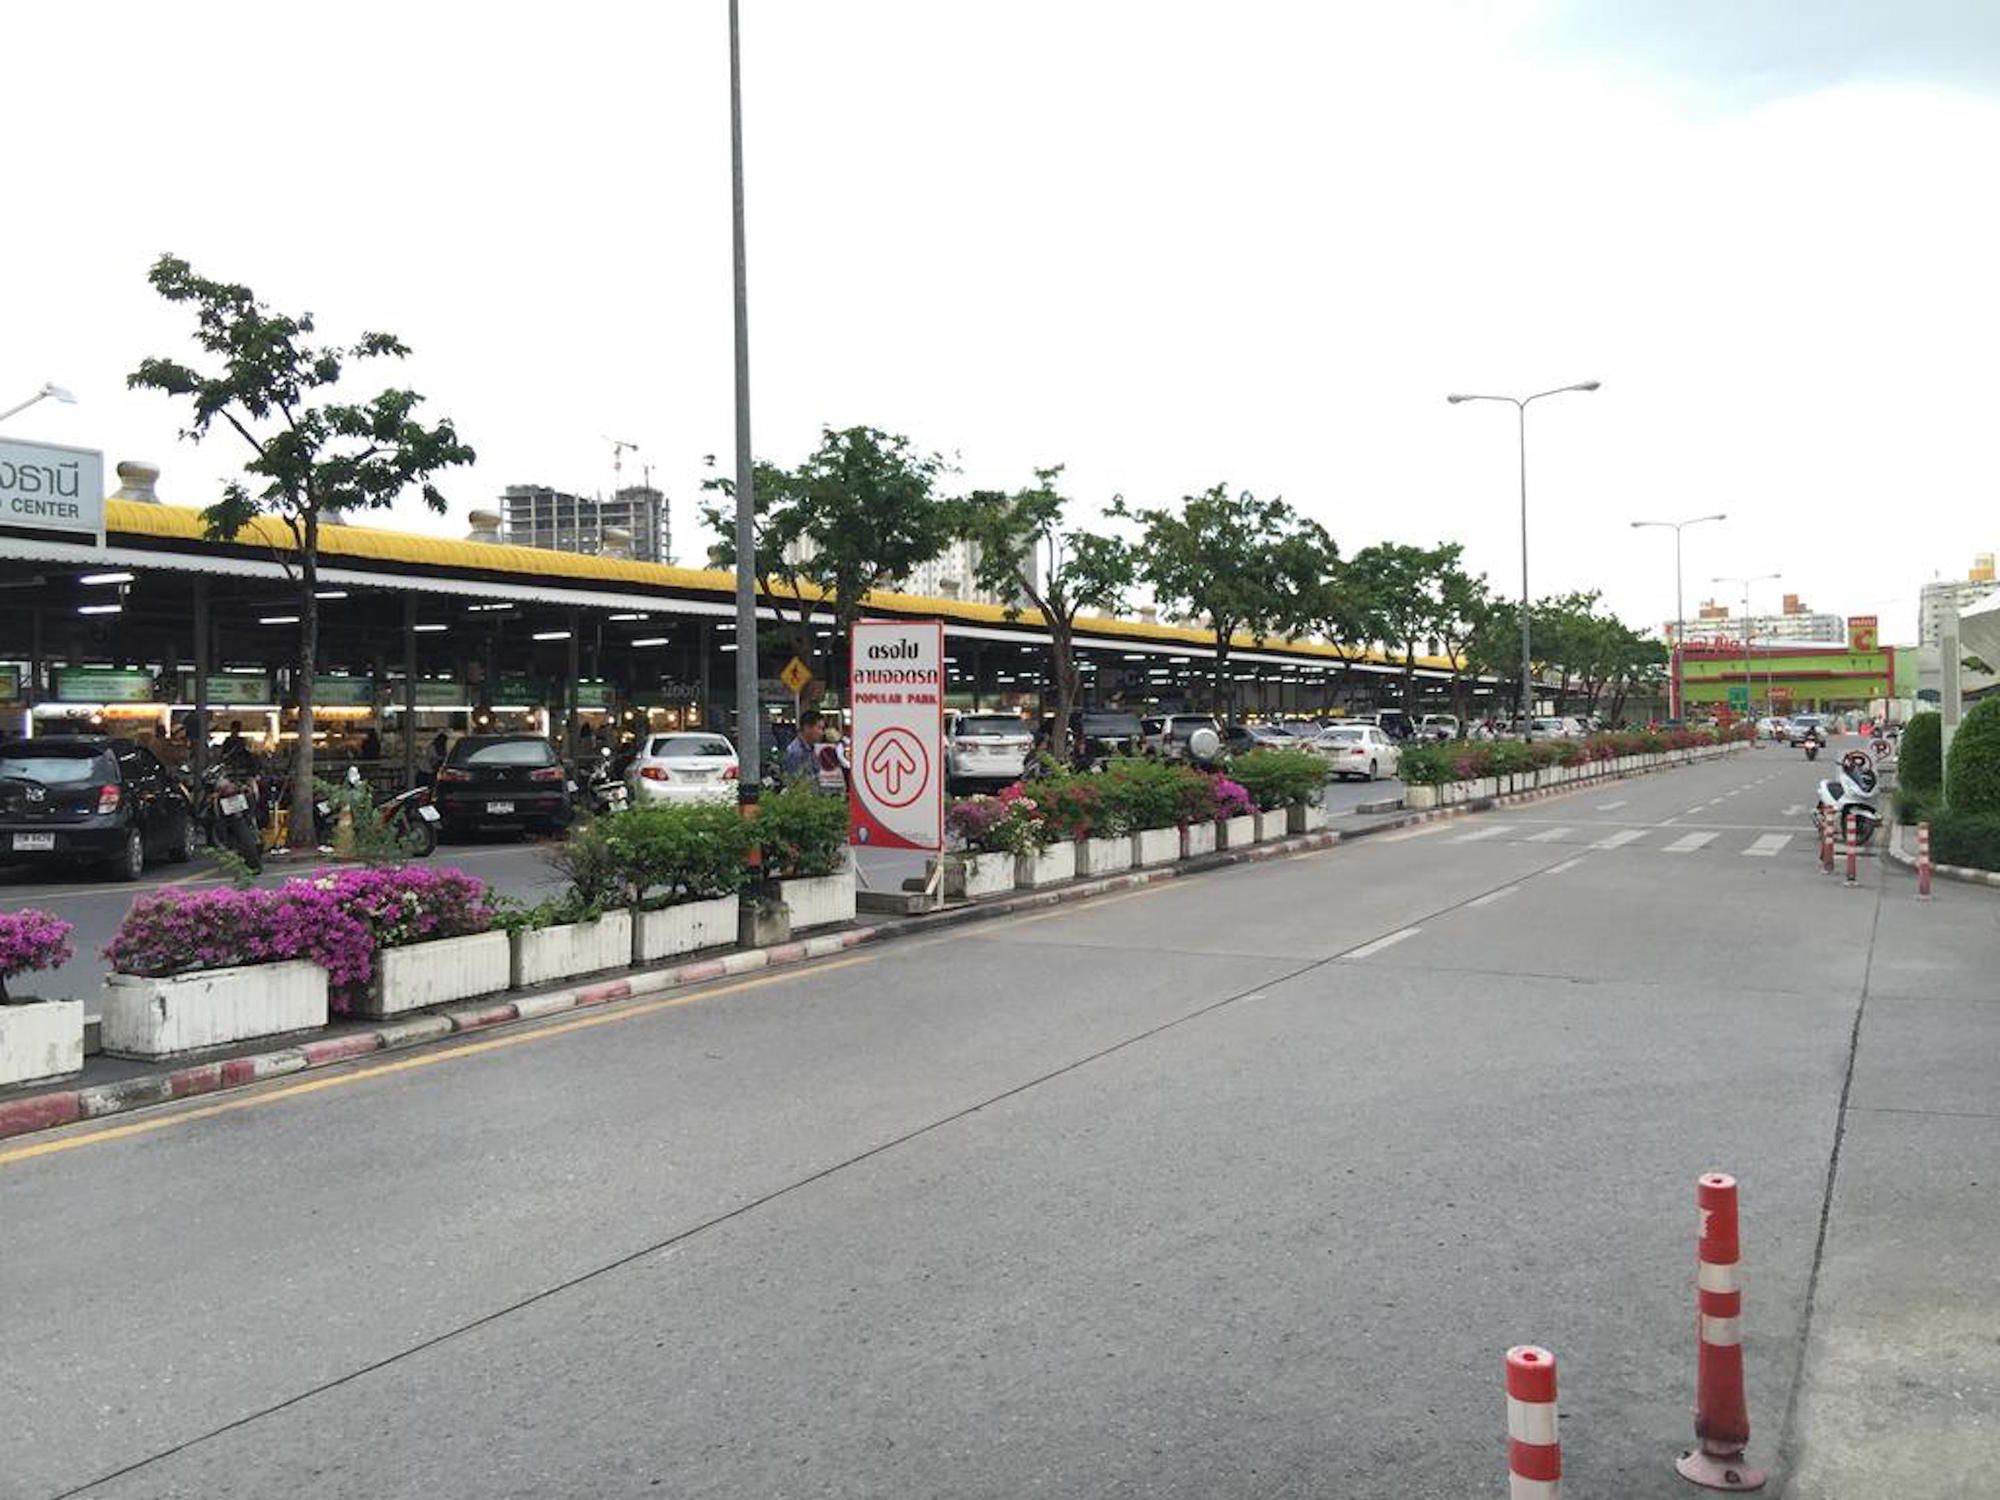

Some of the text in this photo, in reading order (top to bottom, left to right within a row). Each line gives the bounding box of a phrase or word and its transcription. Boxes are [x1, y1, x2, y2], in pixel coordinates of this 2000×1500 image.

[11, 497, 79, 519] CENTER
[868, 638, 919, 660] ตรงไป
[855, 669, 938, 685] ลานจอดรถ
[855, 693, 938, 705] POPULAR PARK
